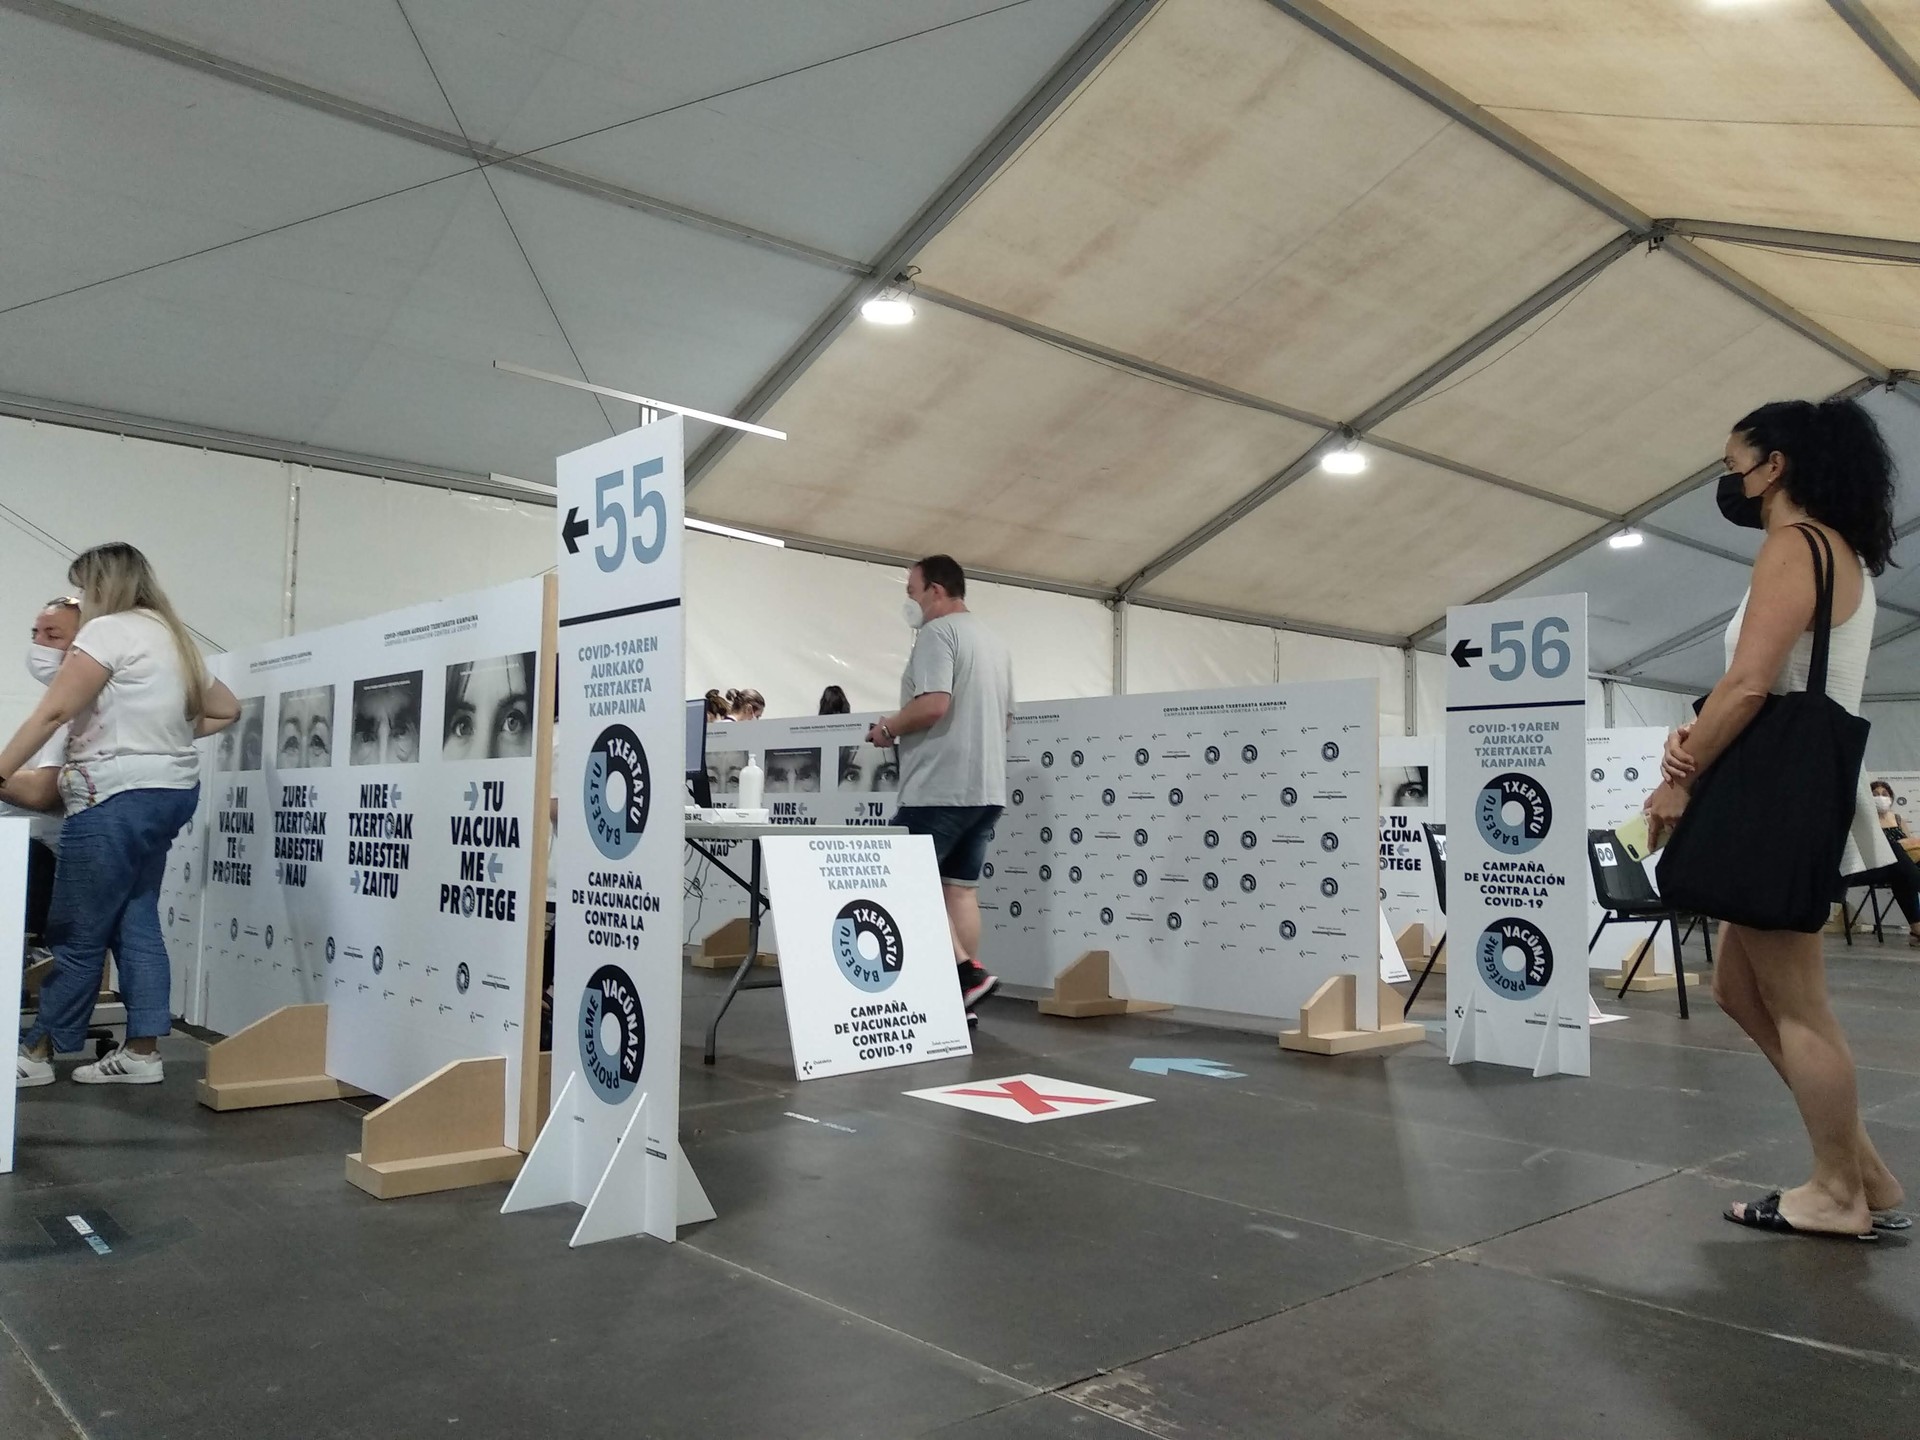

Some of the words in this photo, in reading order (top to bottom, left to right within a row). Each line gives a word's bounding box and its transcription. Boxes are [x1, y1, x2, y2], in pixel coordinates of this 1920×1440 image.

[595, 456, 667, 573] 55
[578, 636, 658, 662] COVID-19AREN
[1489, 616, 1571, 681] 56
[591, 658, 644, 679] AURKAKO
[584, 677, 652, 698] TXERTAKETA
[589, 698, 646, 717] KANPAINA
[1468, 721, 1560, 734] COVID-19AREN
[1483, 734, 1544, 745] AURKAKO
[1474, 745, 1553, 757] TXERTAKETA
[1481, 757, 1546, 768] KANPAINA
[607, 737, 644, 825] TXERTATU
[236, 786, 248, 808] MI
[281, 785, 307, 808] ZURE
[360, 783, 388, 808] NIRE
[482, 781, 504, 812] TU
[590, 762, 621, 845] BABESTU
[773, 802, 796, 815] NIRE
[868, 802, 883, 817] TU
[1503, 781, 1545, 834] TXERTATU
[219, 811, 255, 834] VACUNA
[275, 811, 327, 835] TXERTOAK
[348, 812, 413, 839] TXERTOAK
[1390, 815, 1407, 828] TU
[1483, 795, 1519, 846] BABESTU
[450, 816, 520, 848] VACUNA
[1379, 829, 1422, 843] CUNA
[227, 837, 236, 858] TE
[274, 837, 323, 862] BABESTEN
[348, 841, 410, 869] BABESTEN
[710, 844, 729, 856] NAU
[808, 840, 892, 851] COVID-19AREN
[460, 851, 485, 882] ME
[826, 853, 881, 864] AURKAKO
[1379, 857, 1422, 871] OTEGE
[1483, 861, 1545, 873] CAMPAÑA
[212, 860, 251, 886] PROTEGE
[285, 863, 307, 887] NAU
[588, 870, 642, 890] CAMPAÑA
[819, 865, 891, 877] TXERTAKETA
[1464, 872, 1479, 882] DE
[1482, 873, 1565, 885] VACUNACIÓN
[362, 870, 399, 899] ZAITU
[828, 878, 888, 890] KANPAINA
[1480, 885, 1530, 896] CONTRA
[1533, 887, 1549, 897] LA
[439, 883, 517, 922] PROTEGE
[572, 889, 585, 905] DE
[587, 890, 660, 912] VACUNACIÓN
[1484, 896, 1544, 909] COVID-19
[585, 910, 628, 929] CONTRA
[631, 914, 645, 931] LA
[588, 929, 640, 951] COVID-19
[853, 908, 897, 966] TXERTATU
[840, 925, 880, 982] BABESTU
[1484, 936, 1526, 992] PROTÉGEME
[1502, 925, 1545, 982] VACÚNATE
[850, 1000, 908, 1018] CAMPAÑA
[602, 978, 639, 1075] VACÚNATE
[834, 1023, 850, 1035] DE
[852, 1011, 927, 1032] VACUNACIÓN
[584, 995, 619, 1090] PROTÉGEME
[852, 1031, 899, 1046] CONTRA
[901, 1028, 915, 1041] LA
[859, 1043, 913, 1060] COVID-19
